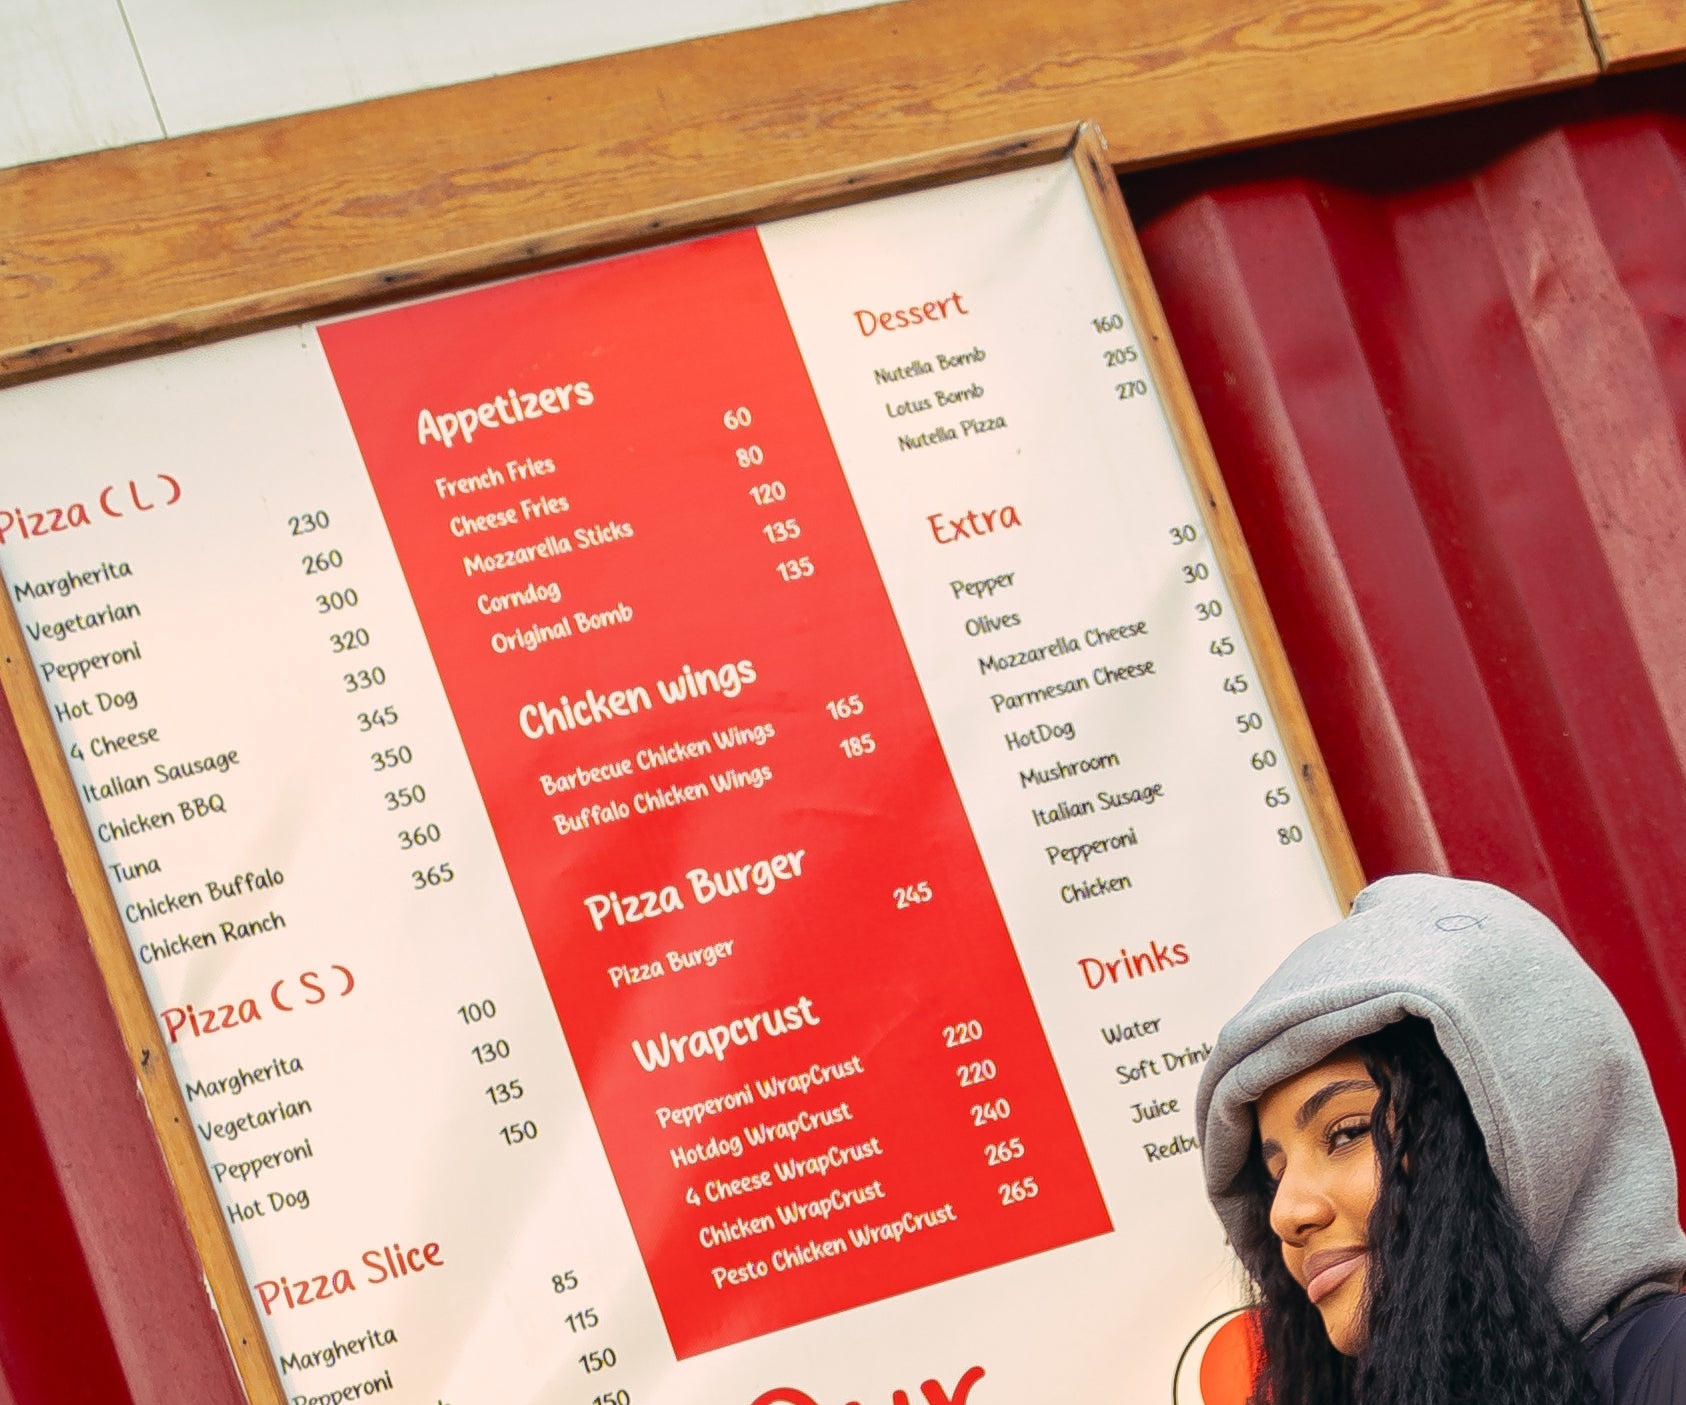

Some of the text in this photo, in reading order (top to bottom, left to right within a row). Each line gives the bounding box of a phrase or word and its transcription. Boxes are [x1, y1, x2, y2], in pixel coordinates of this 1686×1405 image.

[854, 292, 968, 337] Dessert
[418, 382, 594, 448] Appetizers
[874, 361, 934, 385] Nutella
[886, 399, 932, 418] Lotus
[960, 381, 1146, 436] Pizza 270
[436, 407, 751, 499] French Fries 60
[450, 445, 763, 537] Cheese Fries 80
[0, 504, 91, 544] Pizza
[14, 511, 329, 601] Margherita 230
[464, 481, 786, 576] Mozzarella Sticks 120
[478, 519, 800, 615] Corndog 135
[927, 506, 1022, 544] Extra
[950, 525, 1196, 599] Pepper 30
[26, 550, 343, 641] Vegetarian 260
[41, 588, 358, 681] Pepperoni 300
[491, 557, 814, 653] Original Bomb 135
[966, 613, 1021, 636] Olives
[55, 628, 369, 722] Hot Dog 320
[978, 622, 1147, 675] Mozzarella Cheese
[990, 637, 1234, 713] Parmesan Cheese 45
[91, 666, 385, 757] Cheese 330
[520, 660, 756, 739] Chicken wings
[1004, 723, 1075, 751] HotDog
[83, 705, 398, 802] Italian Sausage 345
[540, 695, 863, 796] Barbecue Chicken Wings 165
[553, 734, 875, 835] Buffalo Chicken Wings 185
[1019, 713, 1262, 789] Mushroom 50
[98, 745, 412, 842] Chicken BBQ 350
[110, 785, 426, 882] Tuna 350
[1032, 784, 1164, 827] Italian Susage
[1045, 788, 1290, 865] Pepperoni 65
[126, 824, 441, 923] Chicken Buffalo 360
[148, 863, 454, 967] Chicken Ranch 365
[584, 850, 805, 931] Pizza Burger
[1061, 877, 1132, 903] Chicken
[608, 881, 932, 988] Pizza Burger 245
[1078, 940, 1190, 990] Drinks
[161, 995, 263, 1045] Pizza
[186, 1000, 496, 1101] Margherita 100
[632, 996, 820, 1071] Wrapcrust
[1101, 1018, 1160, 1045] Water
[198, 1040, 510, 1141] Vegetarian 130
[656, 1020, 982, 1128] Pepperoni WrapCrust 220
[670, 1059, 996, 1168] Hotdog WrapCrust 220
[1116, 1060, 1160, 1084] Soft
[1130, 1100, 1180, 1123] Juice
[214, 1079, 523, 1182] Pepperoni 135
[227, 1120, 538, 1223] Hot Dog 150
[705, 1098, 1010, 1202] Cheese WrapCrust 240
[699, 1138, 1024, 1248] Chicken WrapCrust 265
[711, 1176, 1038, 1289] Pesto Chicken WrapCrust 265
[253, 1242, 444, 1316] Pizza Slice
[279, 1270, 578, 1376] Margherita 85
[565, 1308, 599, 1333] 115
[579, 1348, 616, 1374] 150
